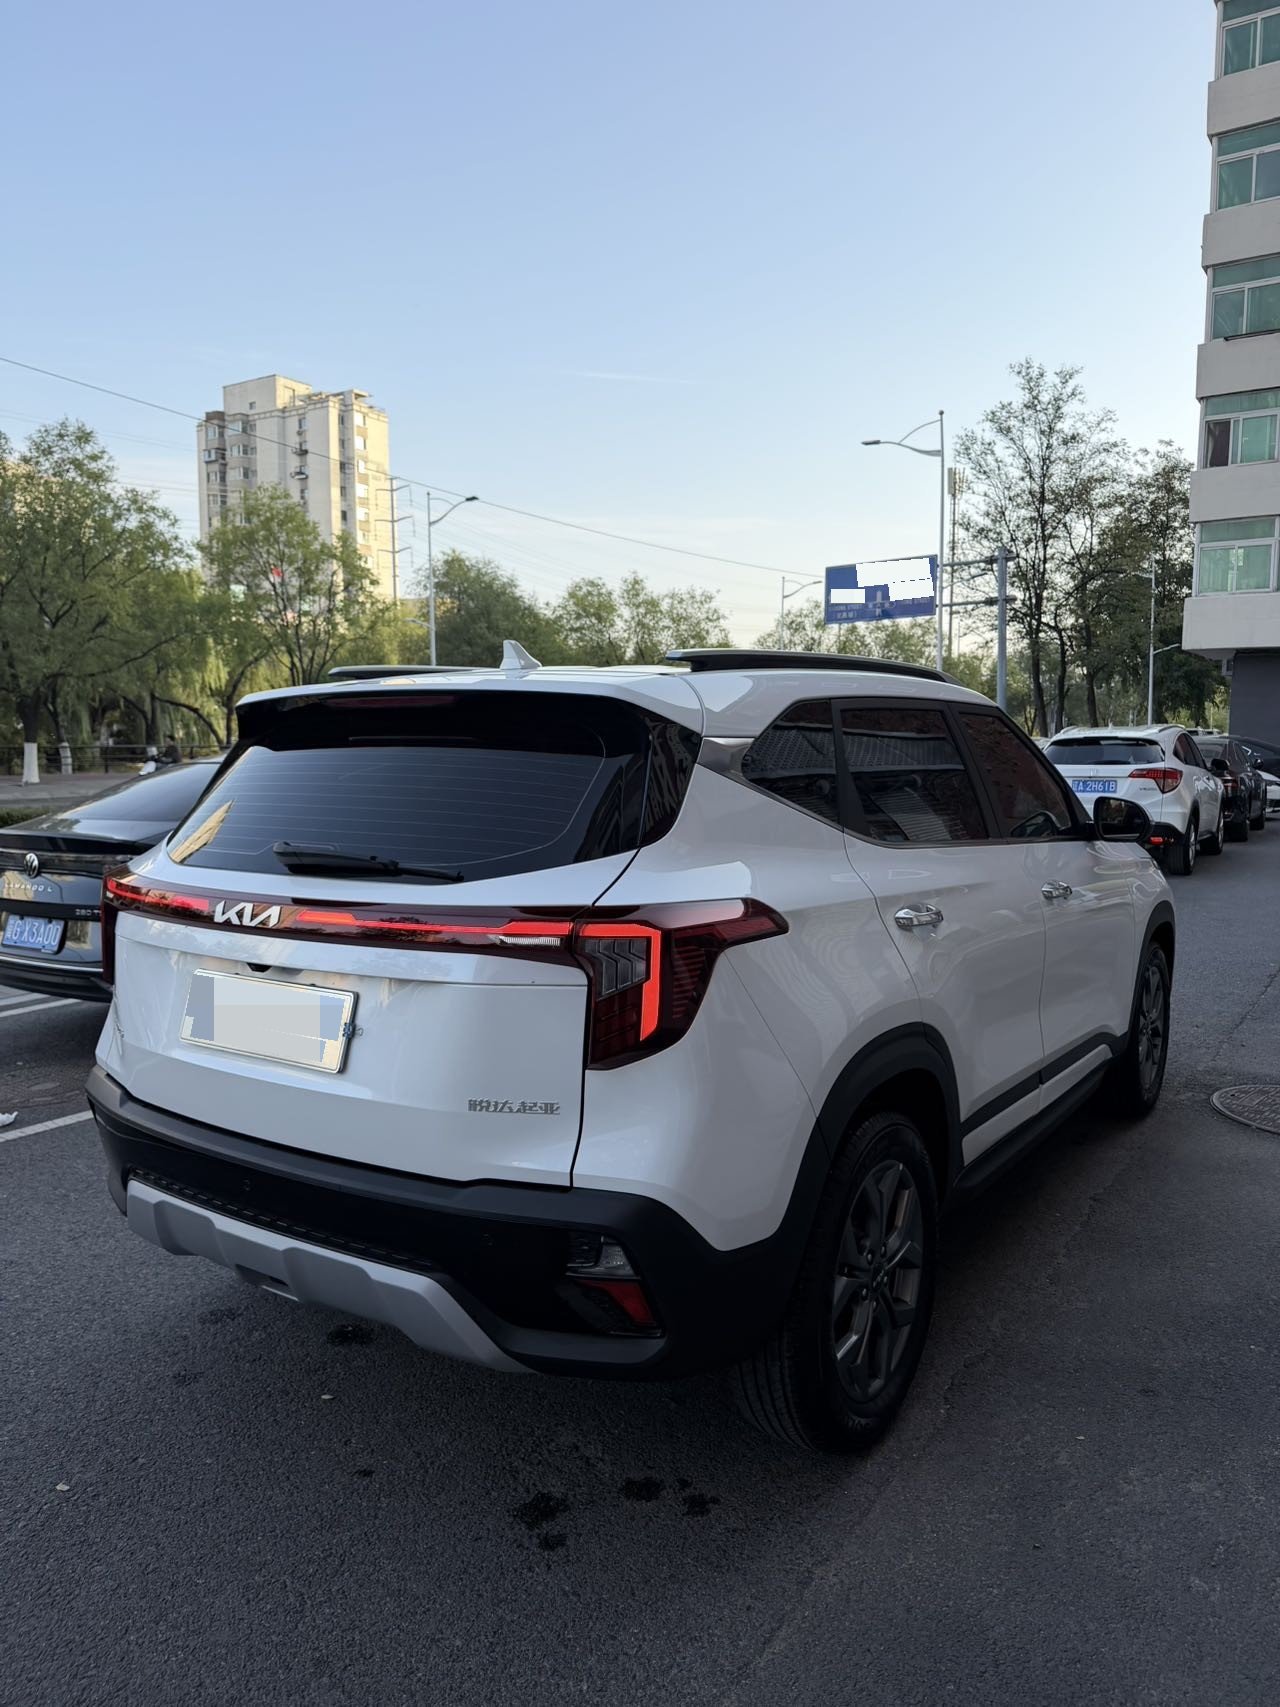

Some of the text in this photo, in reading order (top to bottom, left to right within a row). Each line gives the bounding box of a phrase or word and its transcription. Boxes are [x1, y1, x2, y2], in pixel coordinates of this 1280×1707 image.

[213, 900, 282, 928] KIA
[467, 1098, 561, 1116] 悦达起亚
